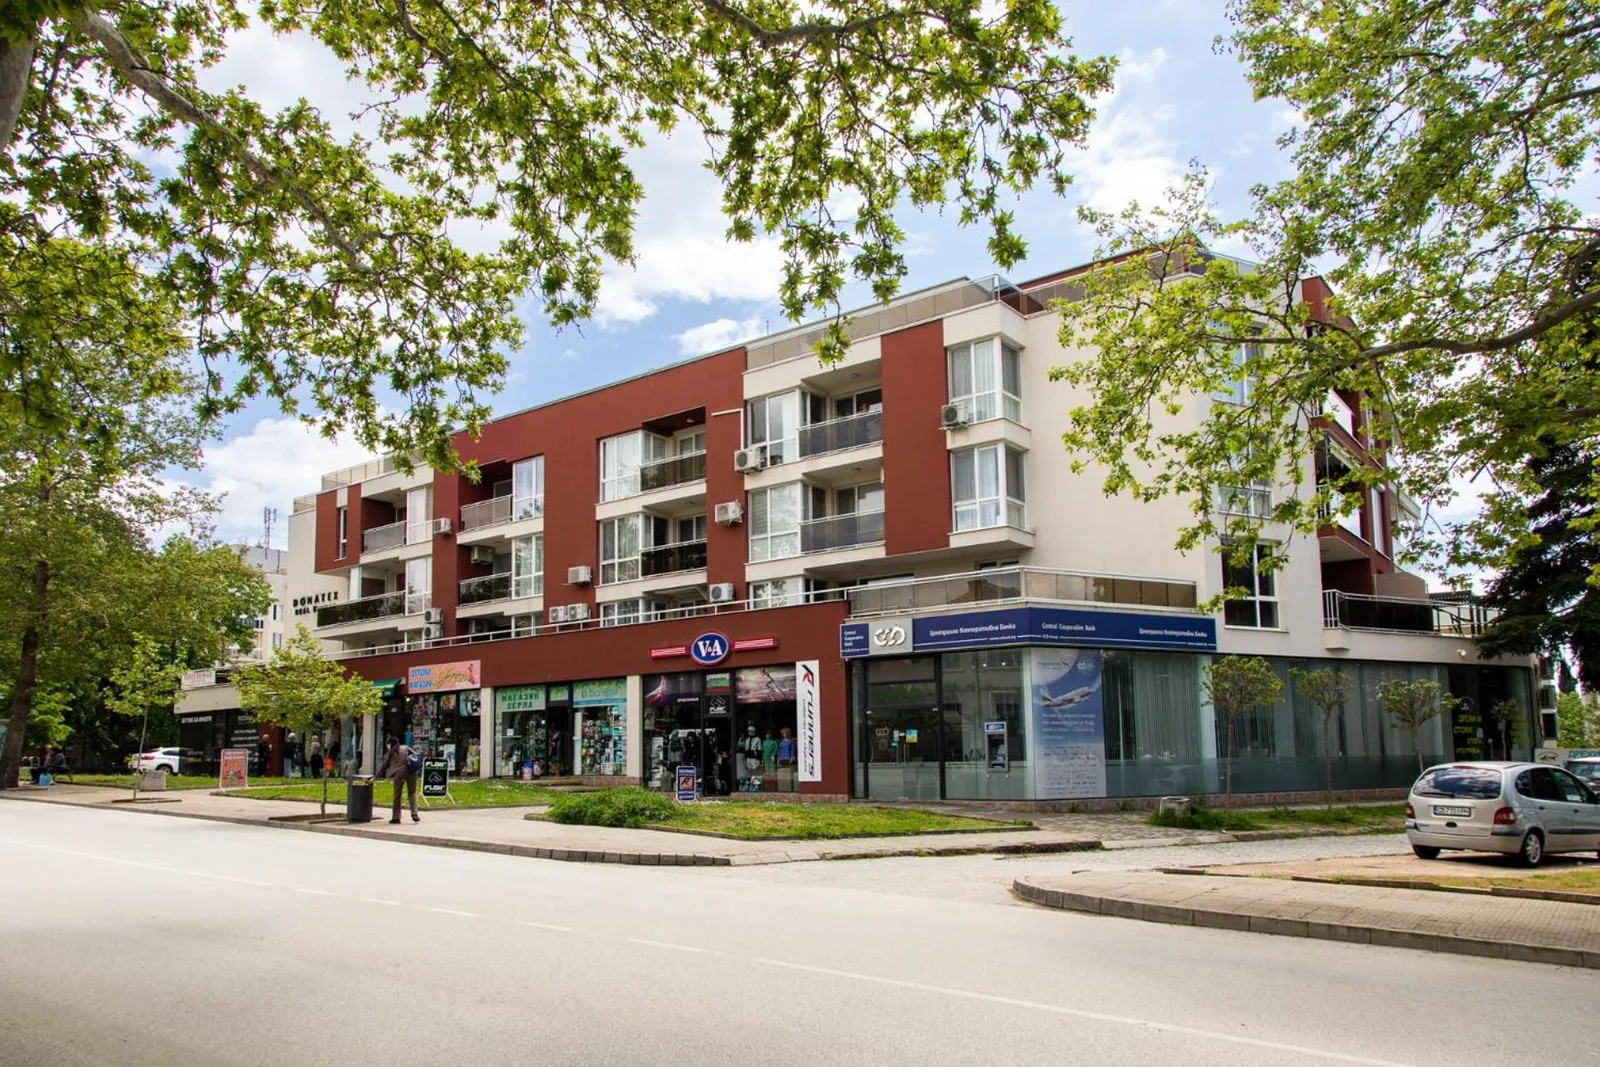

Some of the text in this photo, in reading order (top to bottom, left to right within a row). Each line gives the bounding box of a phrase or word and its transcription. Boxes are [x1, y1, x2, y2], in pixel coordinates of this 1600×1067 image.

[293, 591, 338, 607] DONATEX
[697, 639, 723, 657] V&A
[501, 692, 539, 702] МАГАЗИН
[807, 690, 816, 777] runners
